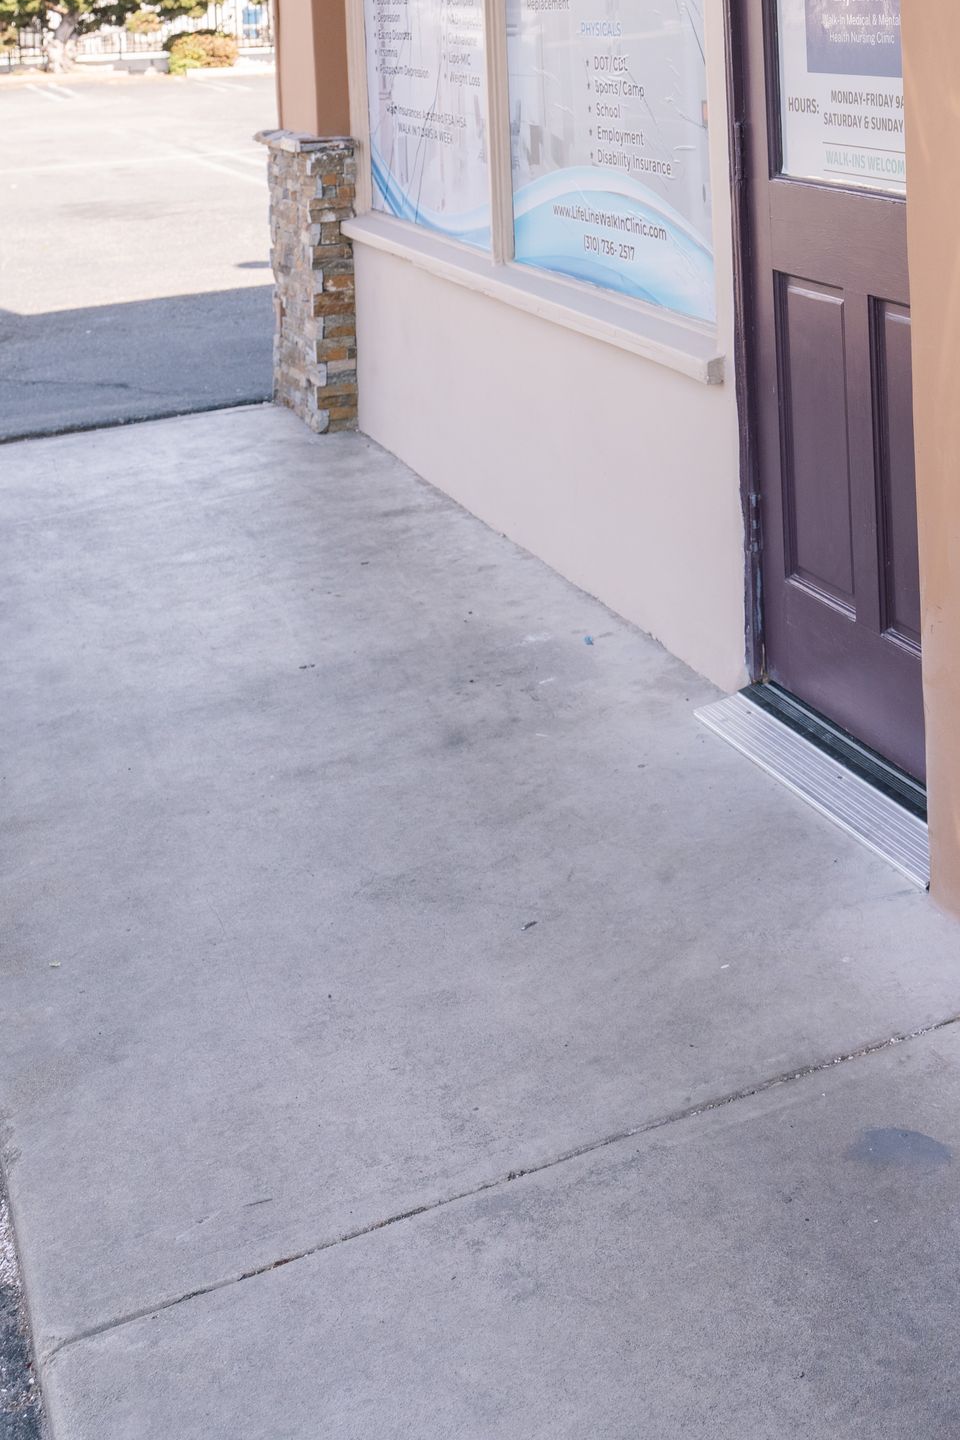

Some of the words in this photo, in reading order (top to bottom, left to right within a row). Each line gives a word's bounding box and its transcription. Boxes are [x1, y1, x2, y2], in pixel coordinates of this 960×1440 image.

[580, 20, 622, 38] PHYSICALS
[846, 14, 871, 27] Medical
[871, 15, 878, 26] &
[829, 31, 851, 43] Health
[850, 32, 876, 46] Nursing
[876, 31, 896, 45] Clinic
[594, 79, 645, 99] Sports/Camp
[788, 96, 820, 115] HOURS:
[830, 90, 894, 109] MONDAY-FRIDAY
[596, 102, 621, 119] School
[823, 112, 862, 129] SATURDAY
[864, 115, 870, 129] &
[871, 116, 904, 134] SUNDAY
[597, 125, 645, 148] Employment
[597, 149, 631, 172] Disability
[632, 157, 672, 176] Insurance
[825, 150, 866, 169] WALK-INS
